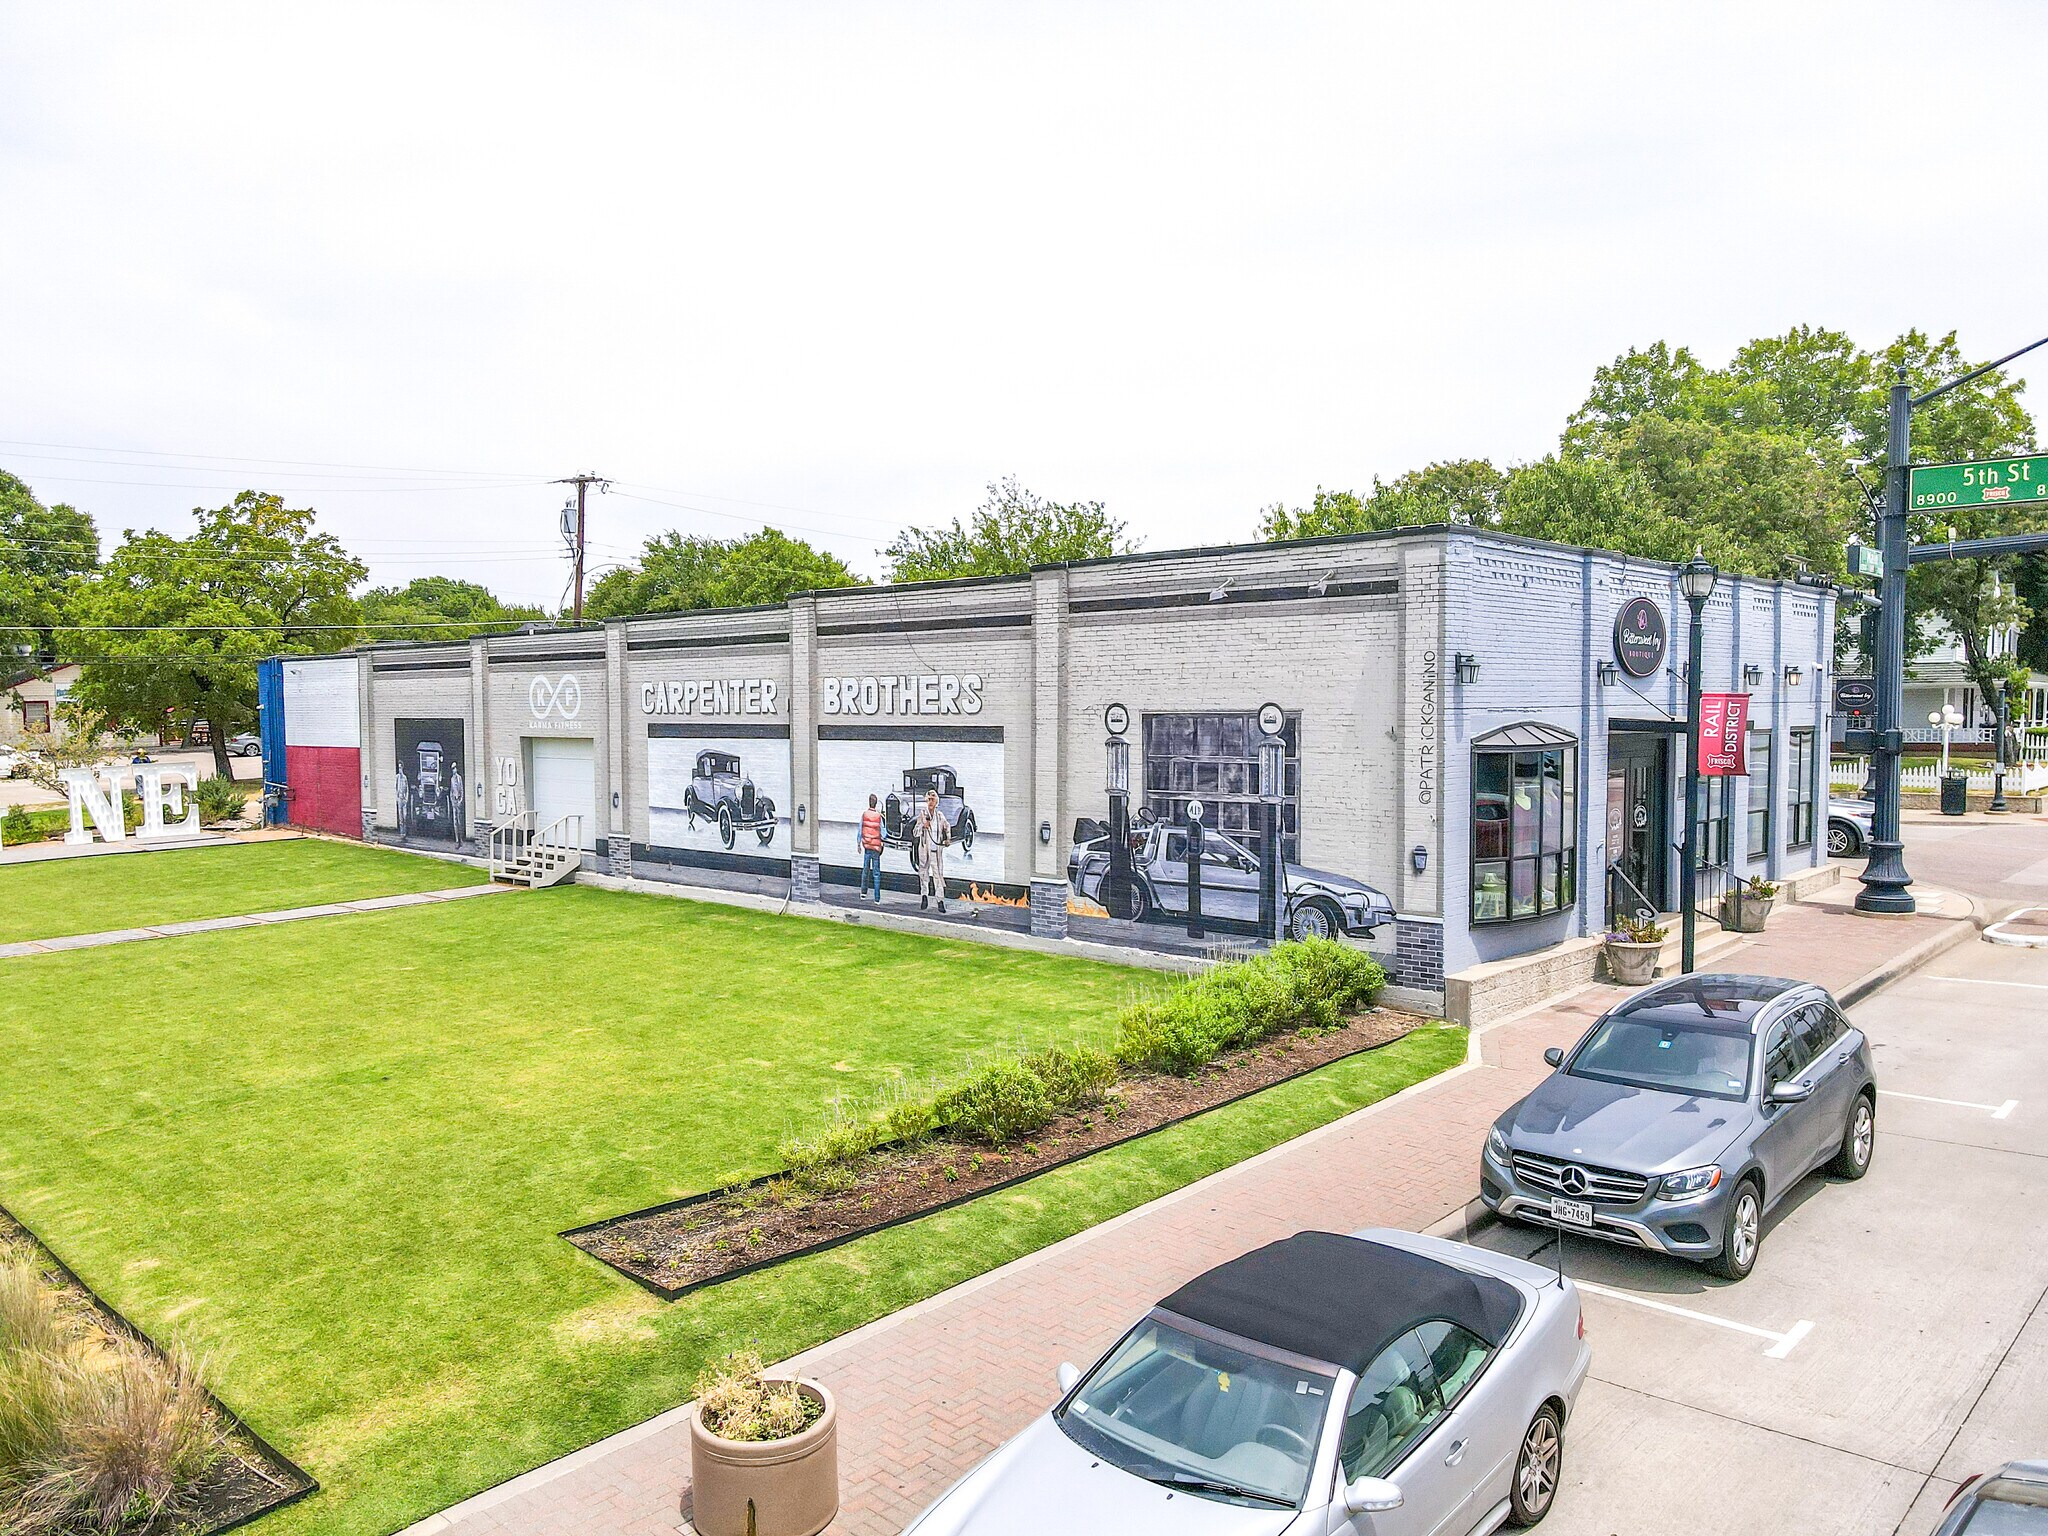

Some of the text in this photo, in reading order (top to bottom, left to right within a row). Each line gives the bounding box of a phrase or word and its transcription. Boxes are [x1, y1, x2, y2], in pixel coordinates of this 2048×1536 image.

[1963, 461, 2030, 486] 5th St
[1916, 491, 1957, 506] 8900
[1629, 650, 1654, 659] BOUTIQUE
[537, 687, 574, 707] K F
[640, 673, 984, 716] CARPENTER BROTHERS
[529, 720, 582, 730] KARMA FITNESS
[1703, 701, 1722, 738] RAIL
[1724, 701, 1741, 752] DISTRICT
[1563, 1200, 1580, 1209] TEXAS
